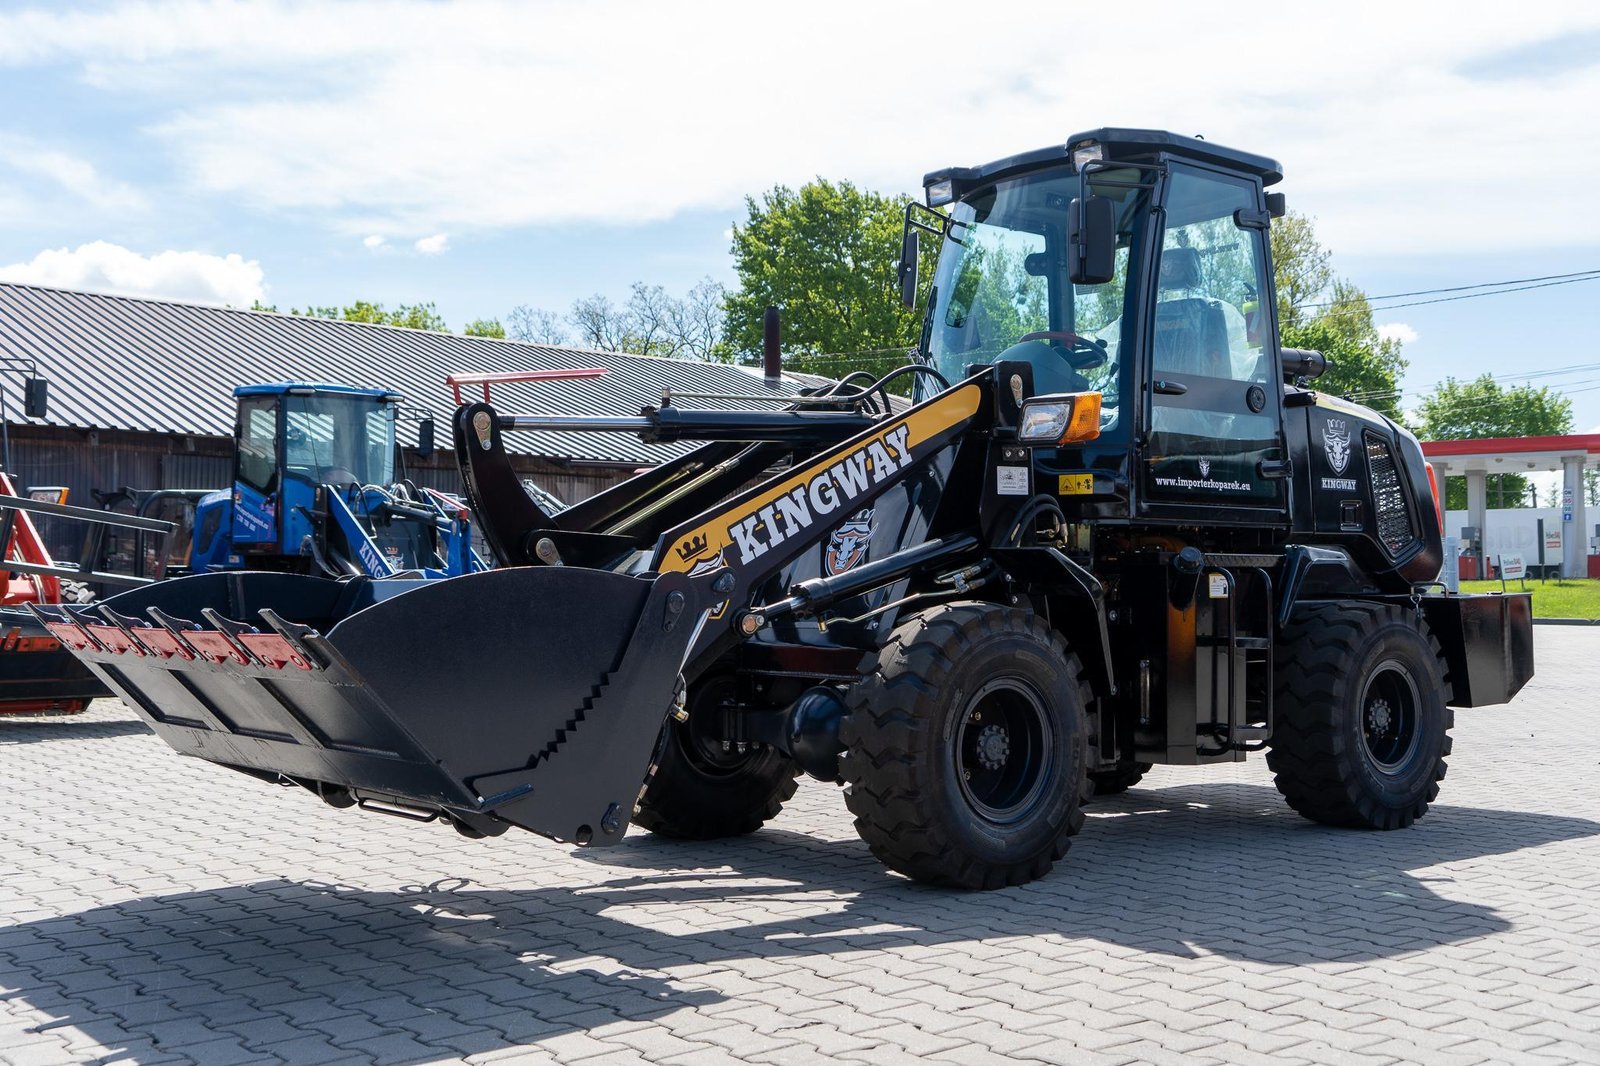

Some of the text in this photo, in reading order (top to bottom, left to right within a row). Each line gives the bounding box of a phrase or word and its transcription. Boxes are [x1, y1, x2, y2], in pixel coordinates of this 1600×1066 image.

[1155, 477, 1251, 491] www.importerkoparek.eu
[1321, 478, 1357, 490] KINGWAY
[729, 425, 913, 566] KINGWAY
